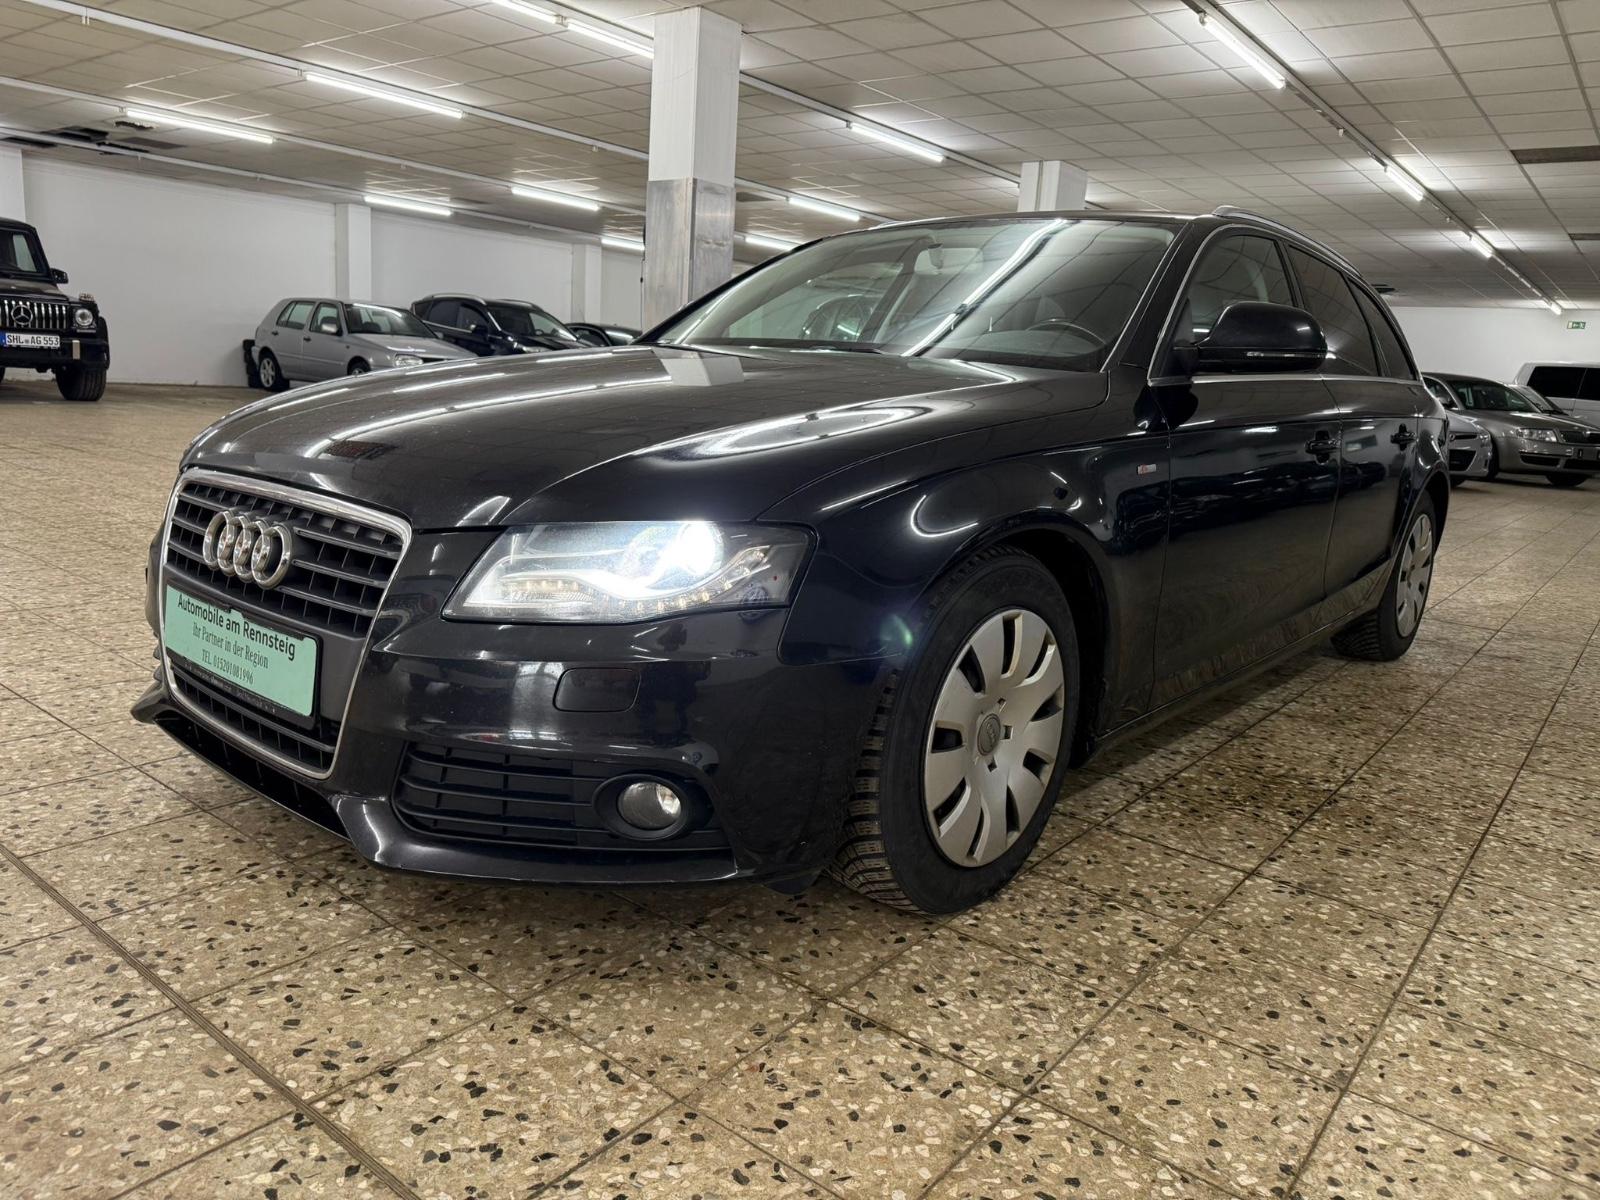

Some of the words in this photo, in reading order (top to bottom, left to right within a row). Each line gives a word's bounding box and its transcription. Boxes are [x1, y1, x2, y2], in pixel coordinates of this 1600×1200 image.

[30, 336, 42, 345] AG
[43, 336, 59, 346] 553
[178, 594, 224, 627] Automobile
[226, 618, 241, 635] am
[243, 621, 296, 661] Rennsteig
[192, 622, 201, 638] Ihr
[202, 626, 224, 649] Partner
[225, 639, 232, 653] in
[232, 642, 244, 658] der
[245, 647, 269, 669] Region
